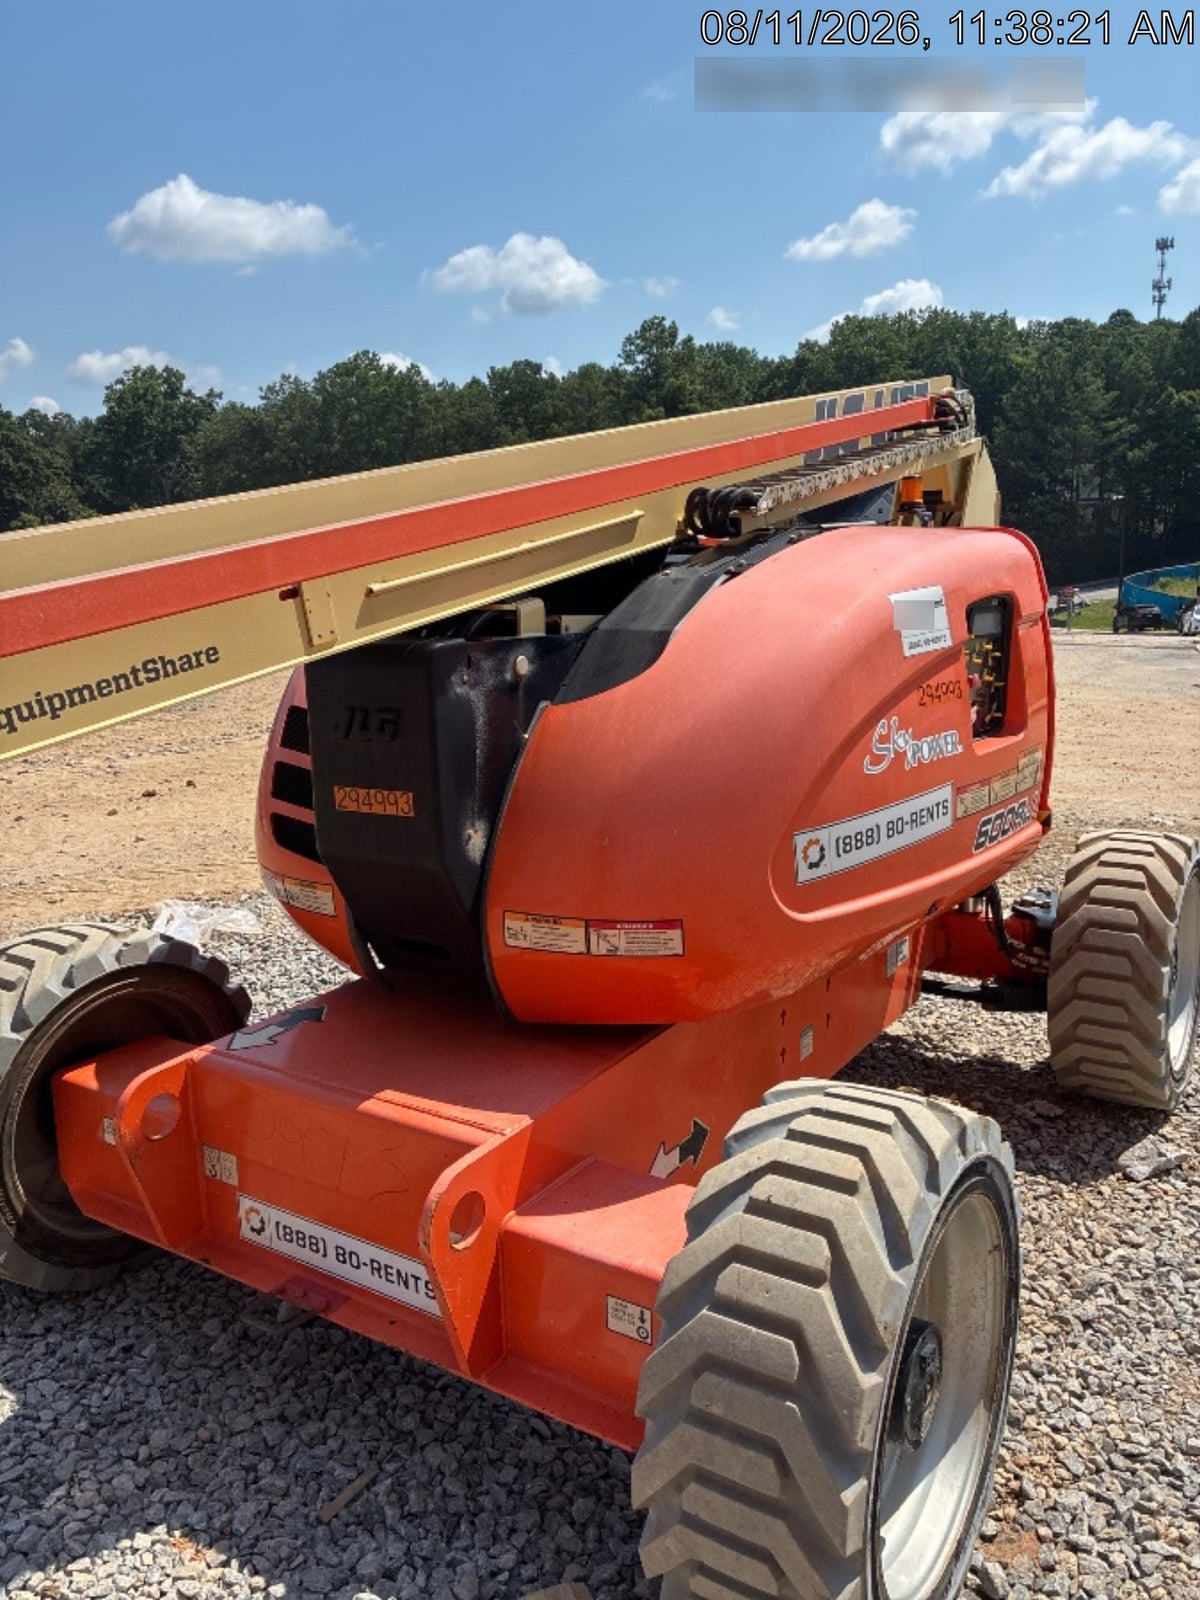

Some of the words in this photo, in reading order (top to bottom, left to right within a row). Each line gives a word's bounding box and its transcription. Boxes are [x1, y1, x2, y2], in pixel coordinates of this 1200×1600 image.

[0, 646, 220, 734] quipmentShare
[336, 786, 412, 815] 294993
[835, 823, 881, 858] (888)
[275, 1221, 328, 1258] (888)
